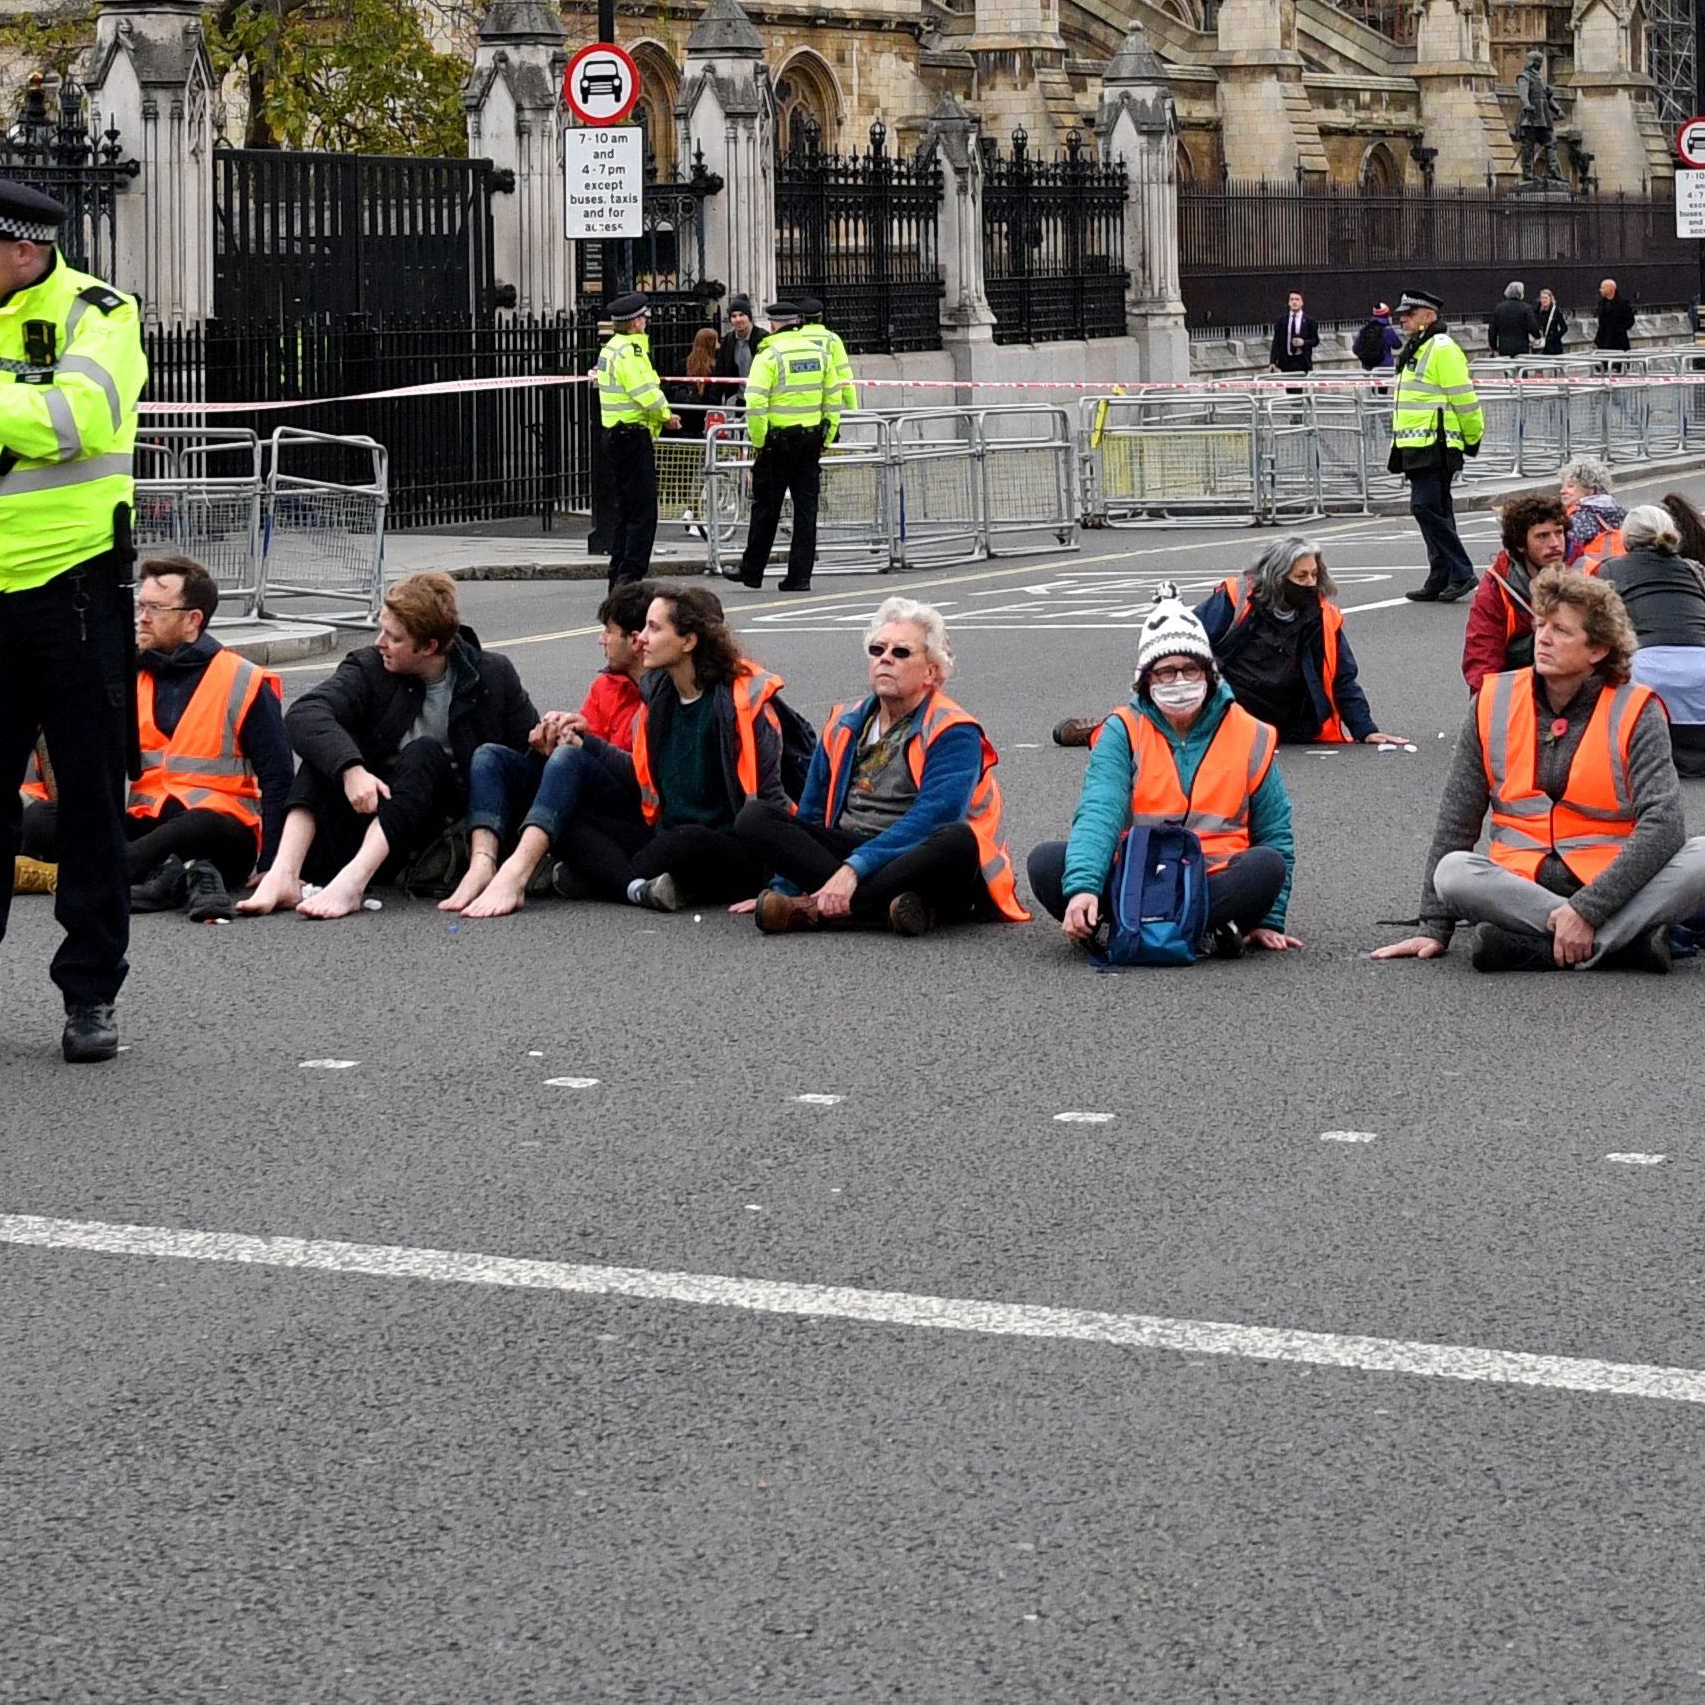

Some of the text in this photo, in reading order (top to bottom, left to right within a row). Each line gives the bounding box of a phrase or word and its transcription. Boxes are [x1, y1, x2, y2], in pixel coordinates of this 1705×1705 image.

[593, 148, 614, 159] and
[584, 180, 623, 191] except
[610, 192, 639, 203] taxis
[583, 207, 625, 218] and for
